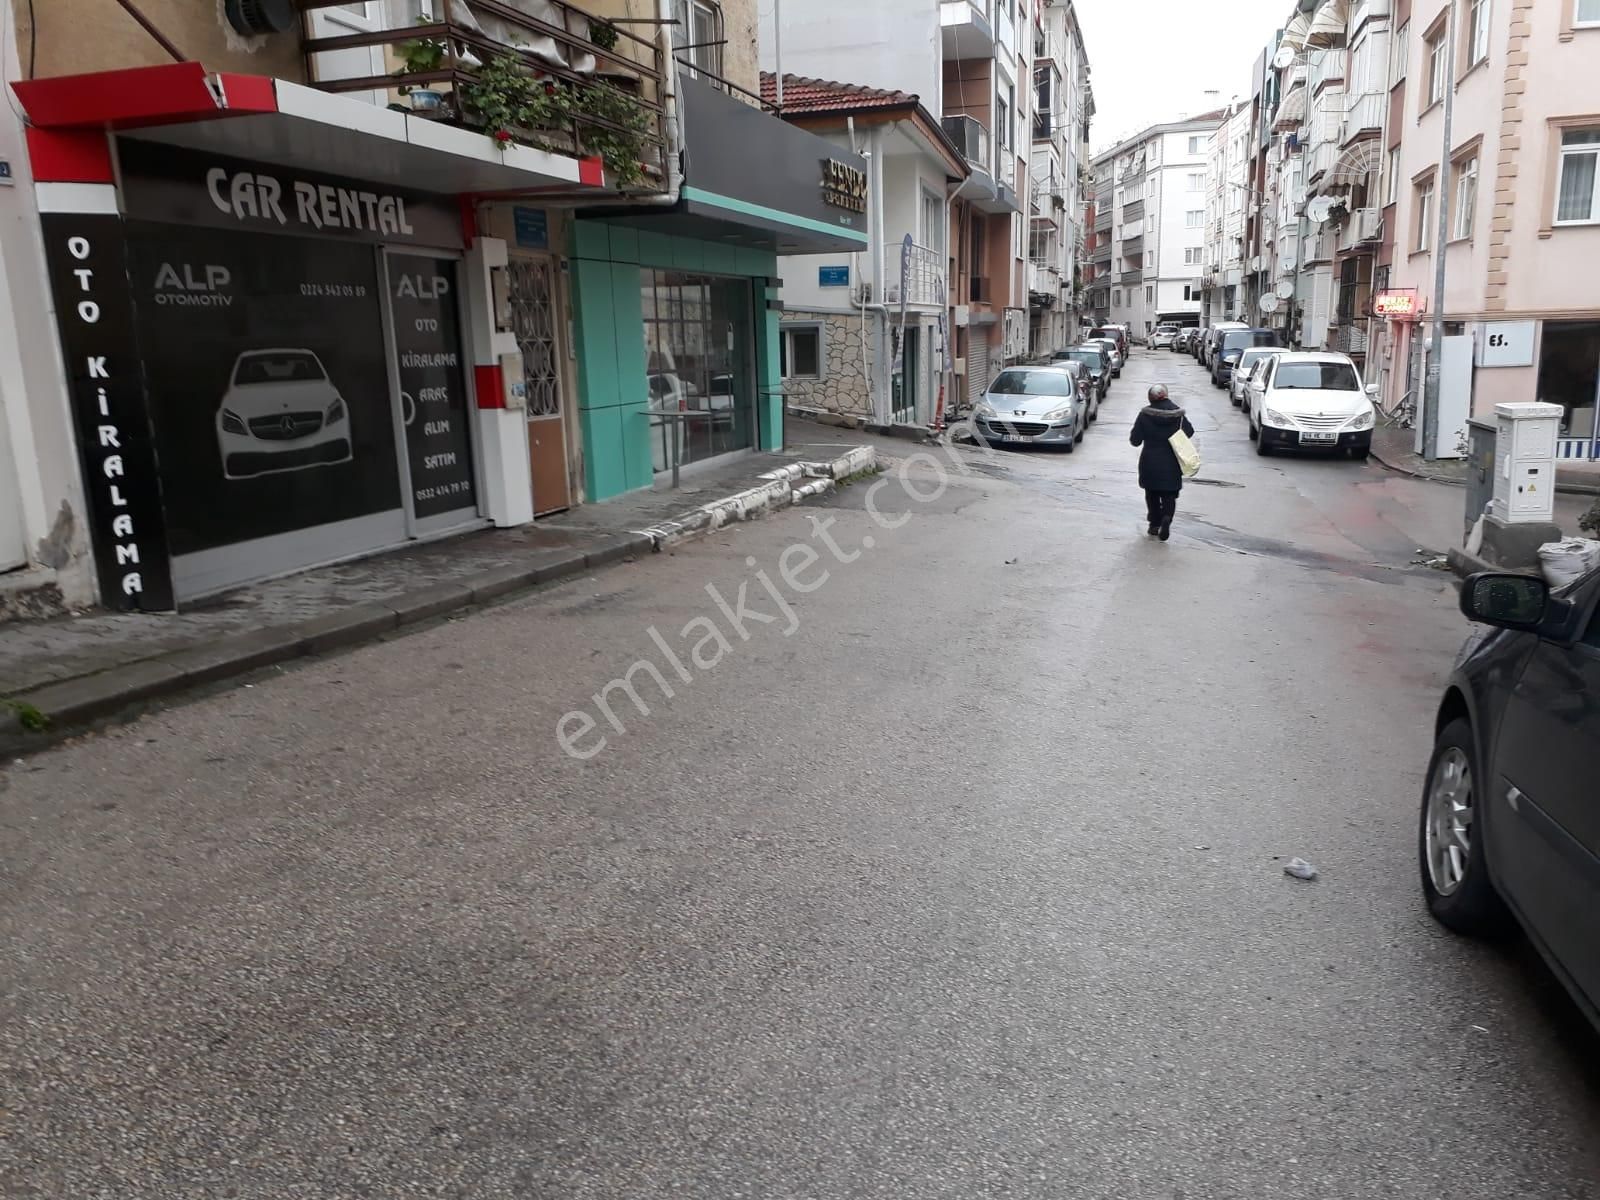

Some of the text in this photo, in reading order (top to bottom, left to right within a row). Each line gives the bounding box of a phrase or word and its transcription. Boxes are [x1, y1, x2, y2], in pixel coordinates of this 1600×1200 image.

[206, 167, 414, 237] CAR RENTAL
[67, 235, 101, 324] OTO
[154, 262, 232, 291] ALP
[397, 274, 450, 299] ALP
[155, 292, 233, 307] OTOMOTİV
[415, 318, 438, 332] OTO
[1489, 335, 1509, 347] ES.
[402, 350, 457, 368] KİRALAMA
[419, 386, 449, 403] ARAÇ
[424, 420, 450, 436] ALIM
[424, 452, 457, 470] SATIM
